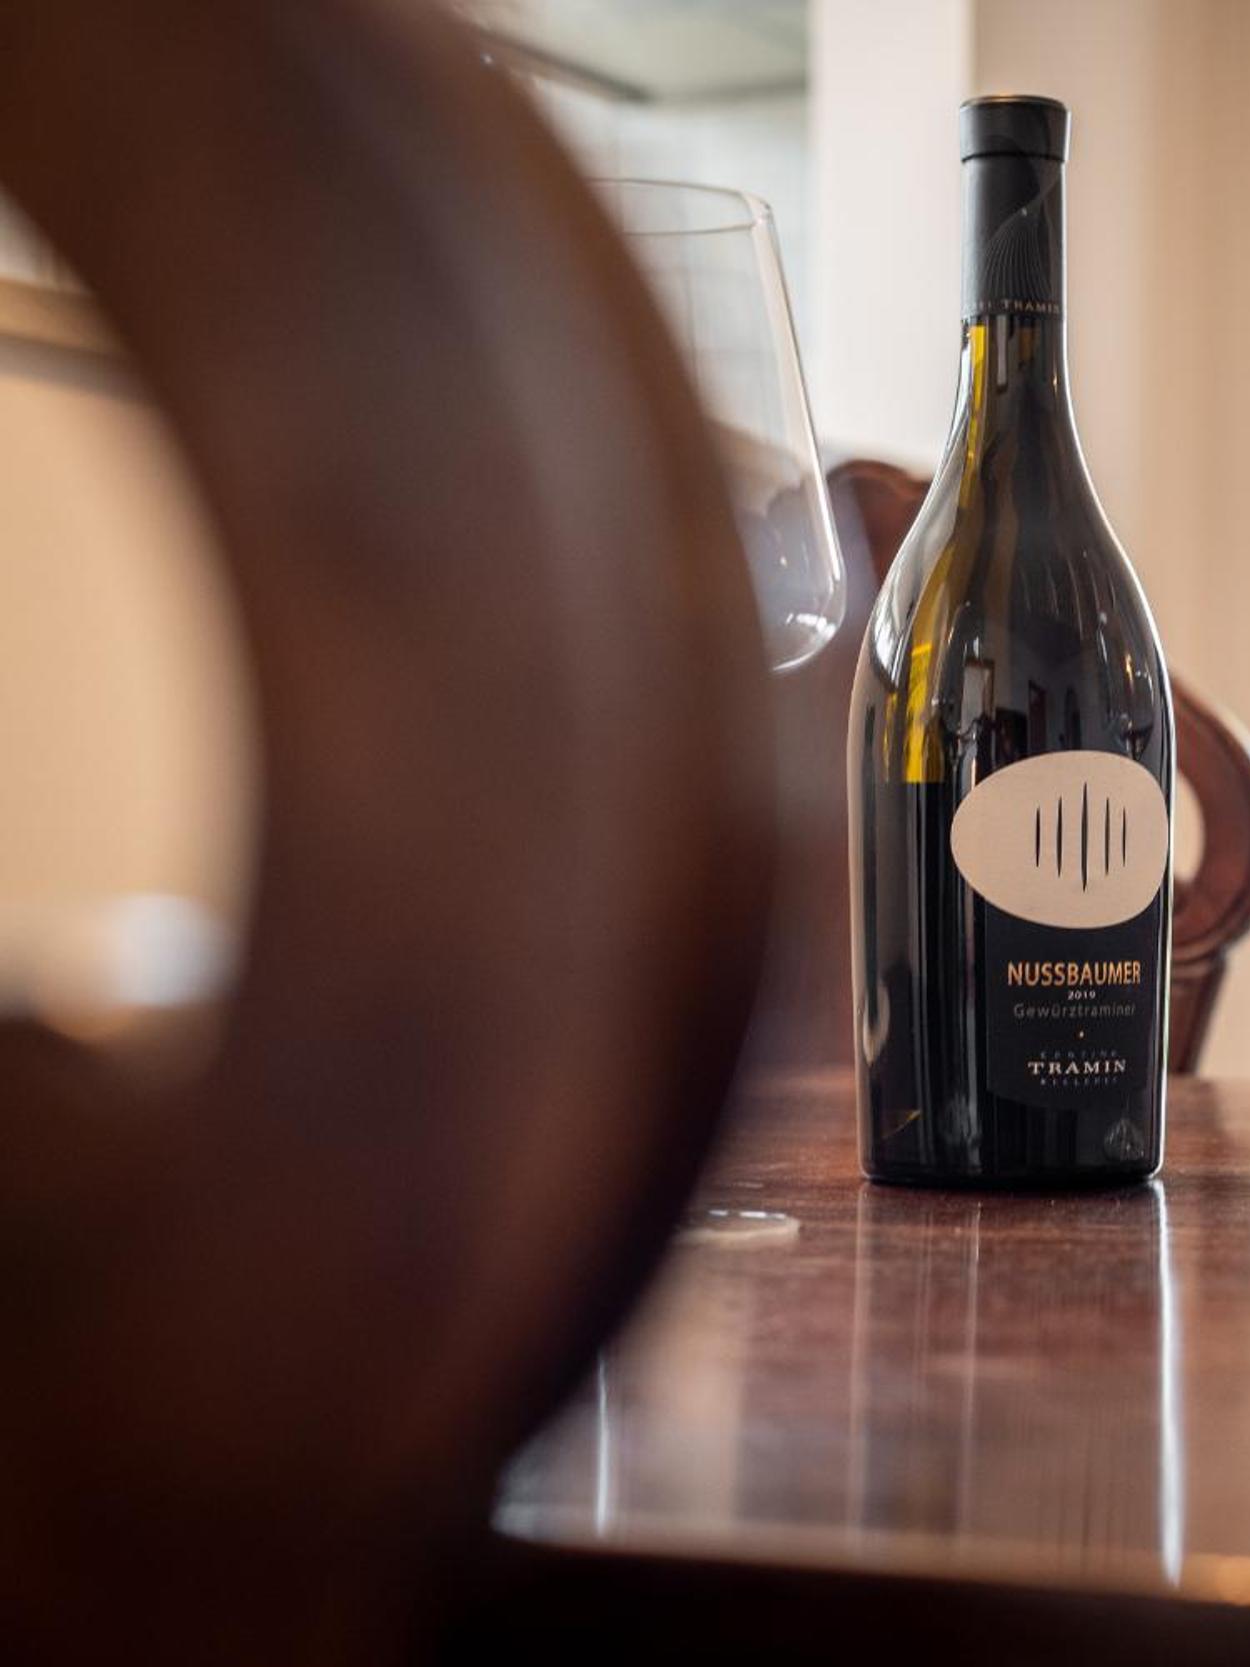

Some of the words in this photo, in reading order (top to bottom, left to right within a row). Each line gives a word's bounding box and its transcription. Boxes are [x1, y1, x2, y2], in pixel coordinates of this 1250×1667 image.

[1007, 962, 1141, 986] NUSSBAUMER
[1067, 990, 1096, 1000] 2019
[1013, 1003, 1136, 1018] Gewürztraminer
[1027, 1060, 1126, 1075] TRAMIN
